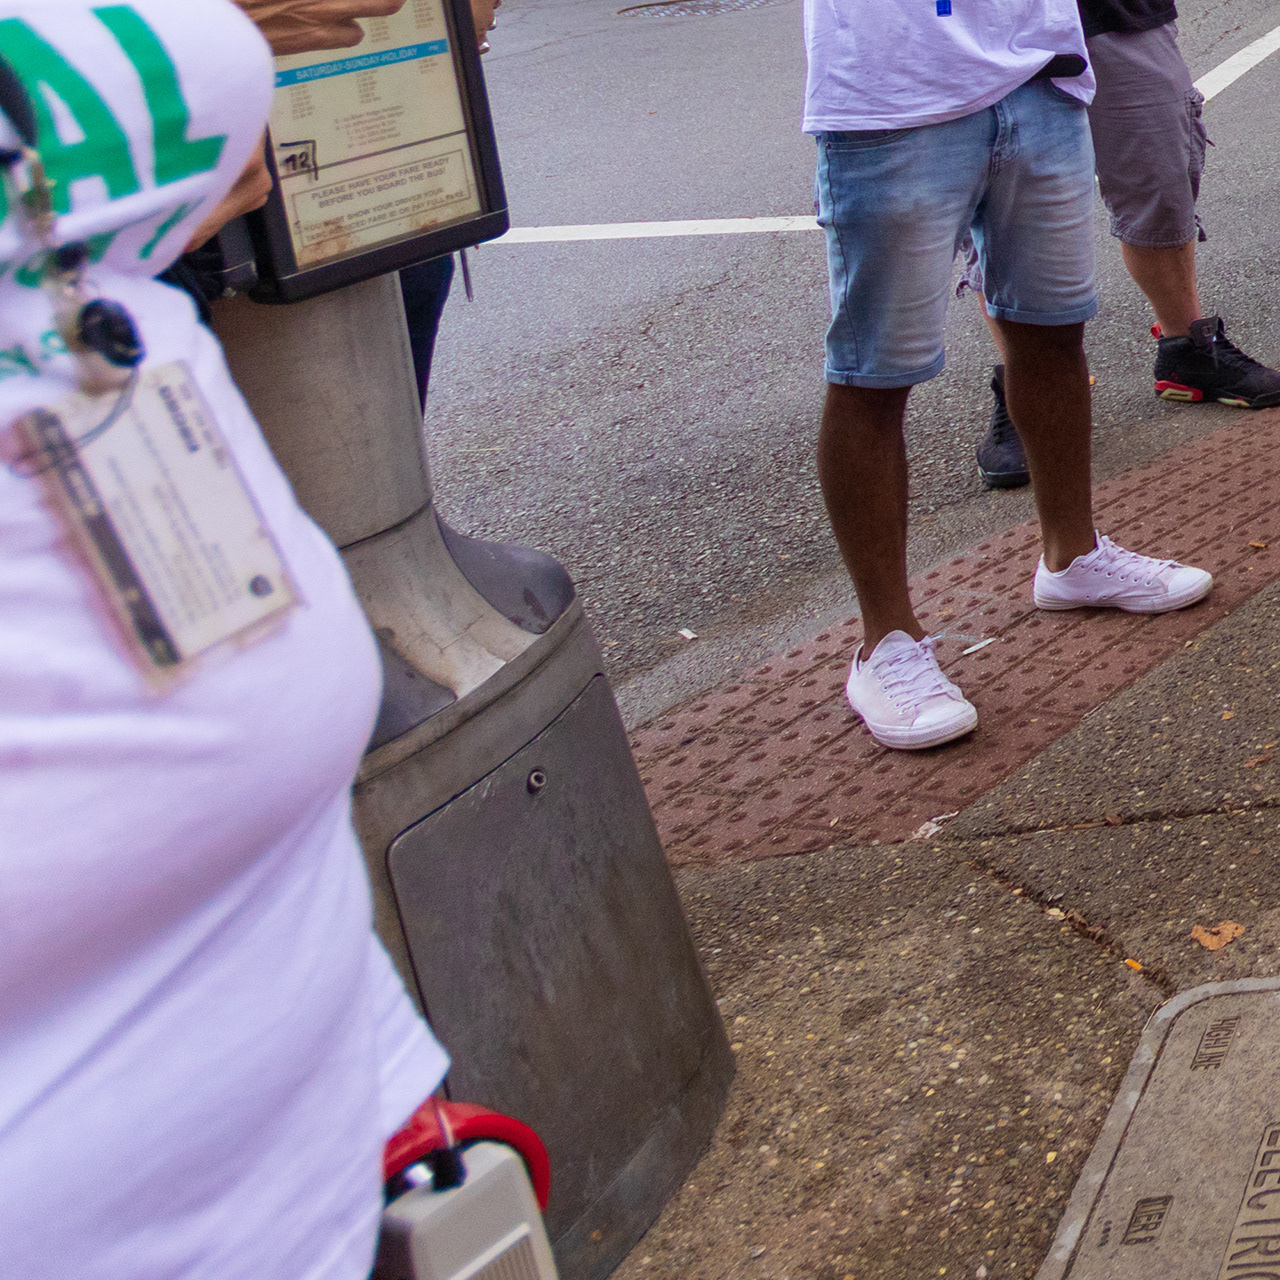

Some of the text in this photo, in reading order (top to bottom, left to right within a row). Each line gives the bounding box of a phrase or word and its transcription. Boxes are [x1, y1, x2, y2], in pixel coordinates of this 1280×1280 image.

[295, 47, 418, 81] SATURDAY-SUNDAY-HOLIDAY
[311, 156, 450, 201] PLEASE HAVE YOUR FARE READY
[318, 193, 355, 209] BEFORE
[357, 186, 376, 199] YOU
[376, 178, 408, 193] BOARD
[408, 172, 426, 184] THE
[367, 212, 389, 226] FARE
[426, 195, 446, 209] FULL
[371, 201, 395, 214] YOUR
[394, 193, 423, 208] DRIVER
[424, 187, 444, 199] YOUR
